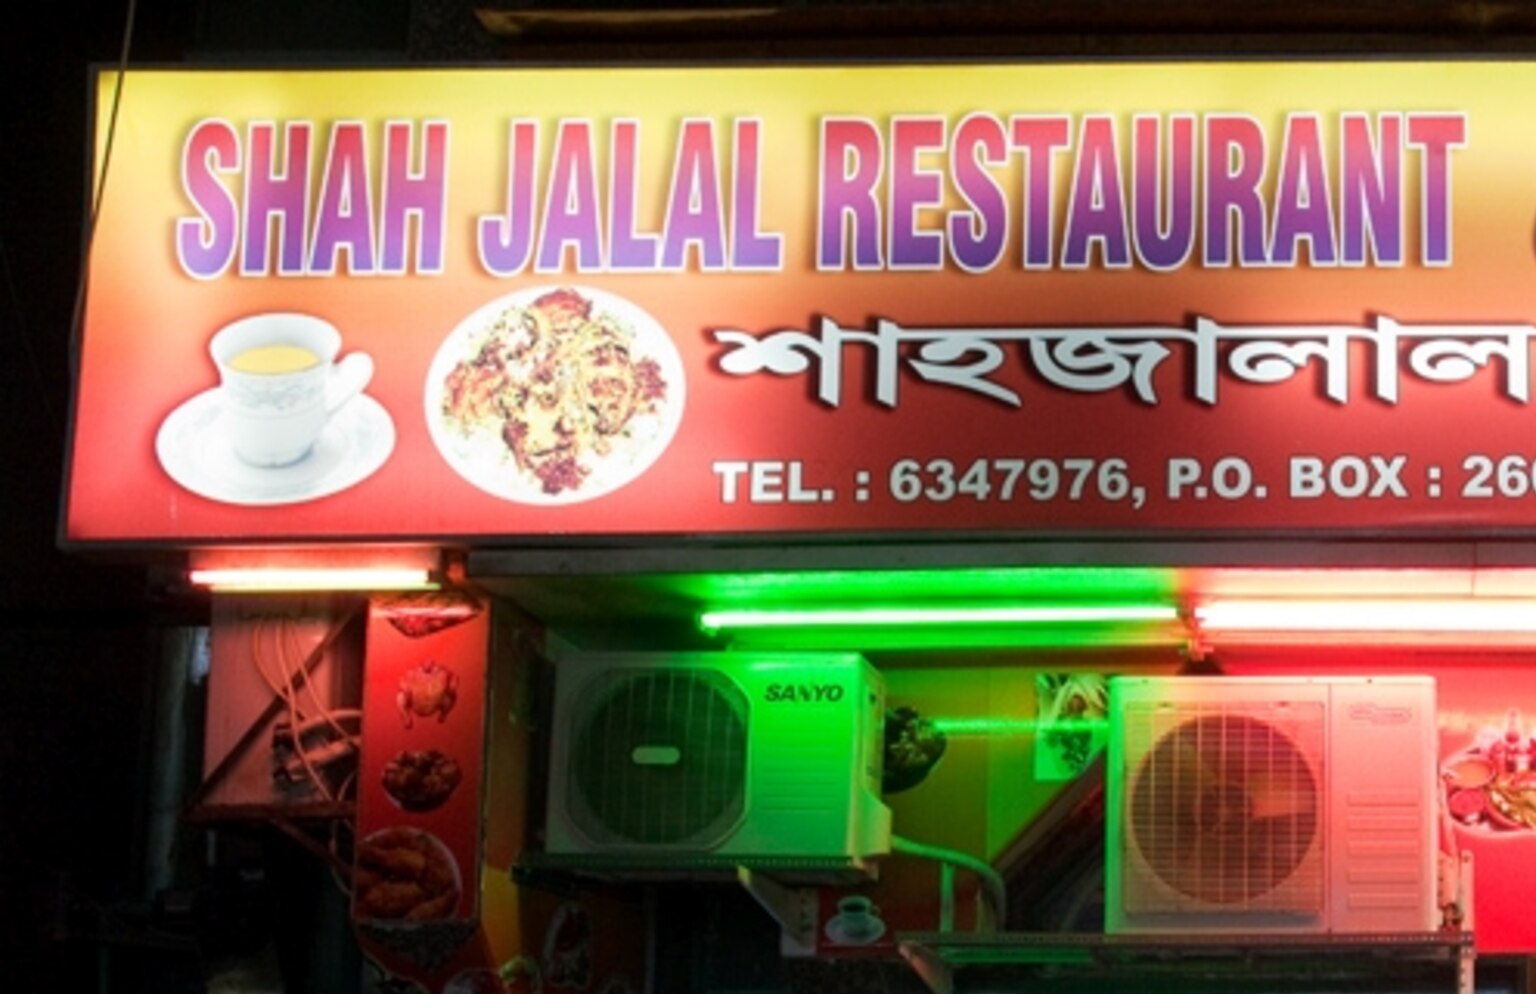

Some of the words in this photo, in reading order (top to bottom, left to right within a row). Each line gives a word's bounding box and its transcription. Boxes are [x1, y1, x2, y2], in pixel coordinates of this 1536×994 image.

[177, 117, 449, 279] SHAH
[477, 117, 783, 277] JALAL
[816, 111, 1468, 273] RESTAURANT
[713, 461, 834, 503] TEL.
[889, 459, 1146, 508] 6347976,
[1167, 458, 1267, 498] P.O.
[1290, 457, 1408, 498] BOX
[764, 684, 844, 703] SANYO
